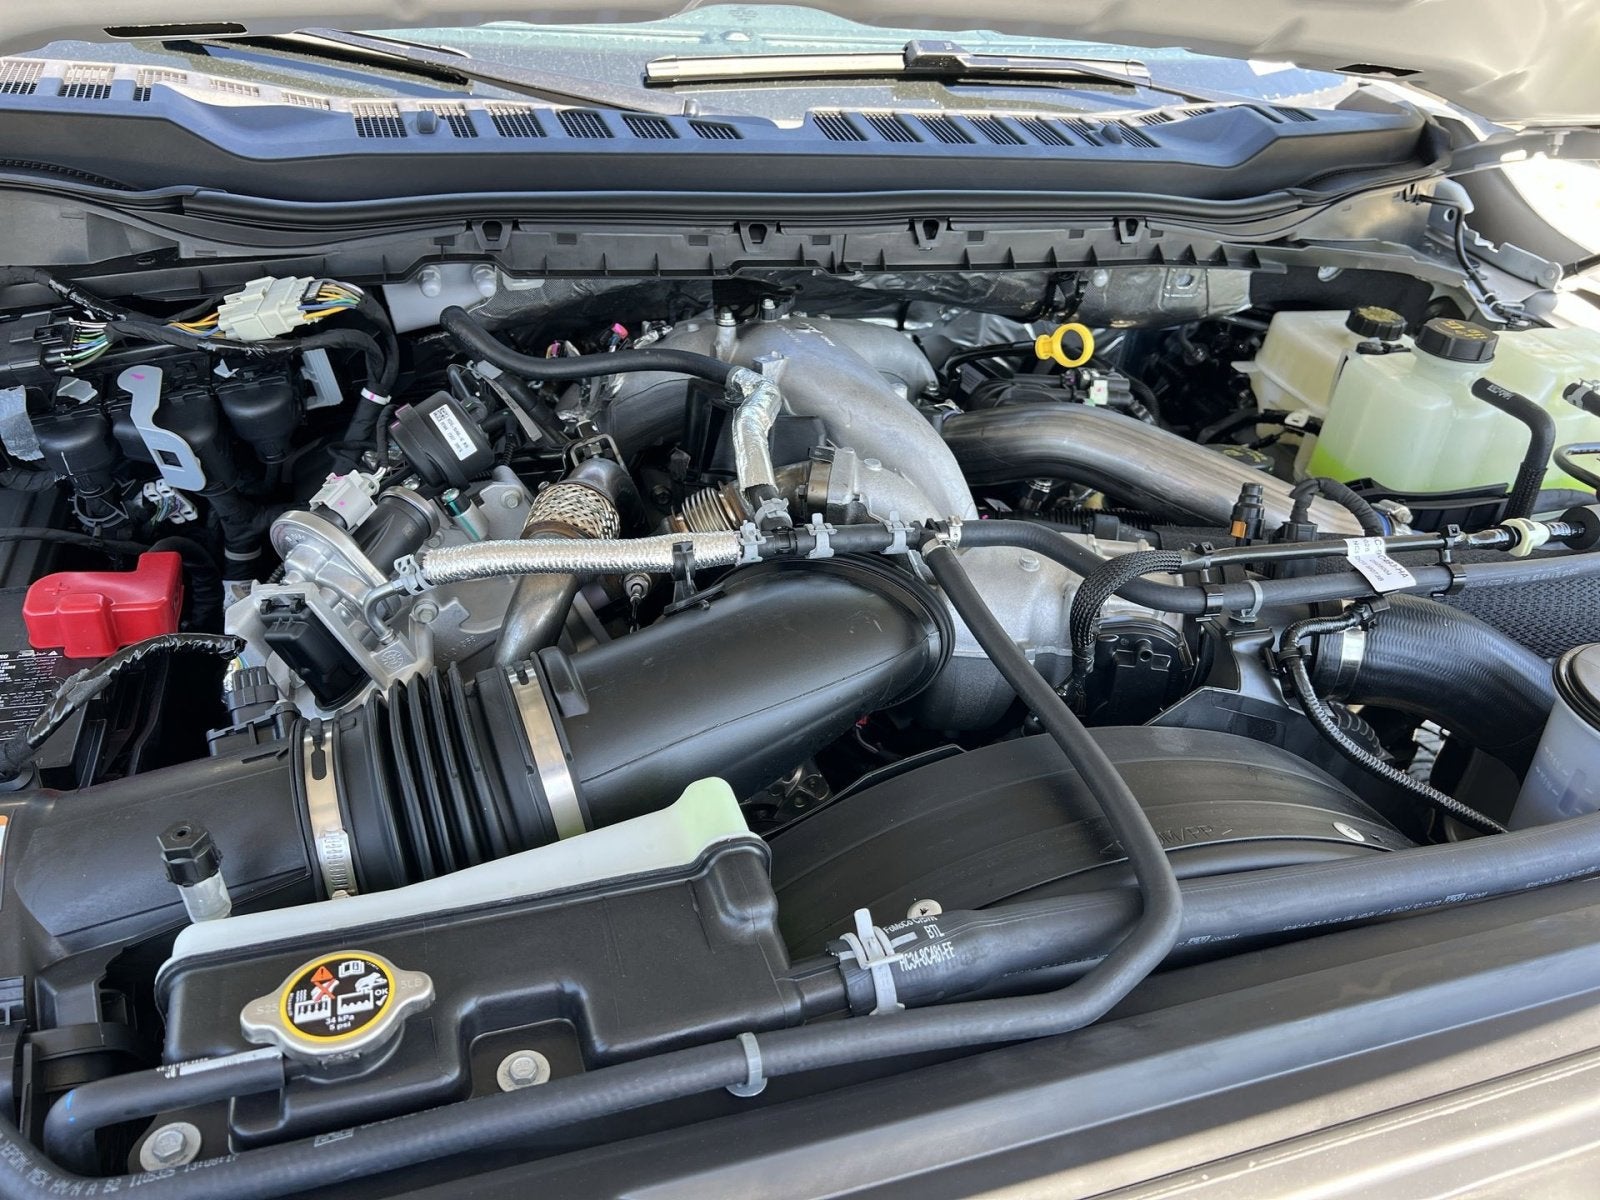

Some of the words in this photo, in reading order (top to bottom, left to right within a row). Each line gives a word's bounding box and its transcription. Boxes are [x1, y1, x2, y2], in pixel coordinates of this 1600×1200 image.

[924, 924, 946, 939] BTL
[374, 987, 388, 997] OK
[337, 1014, 355, 1023] kPa
[336, 1020, 351, 1031] psi
